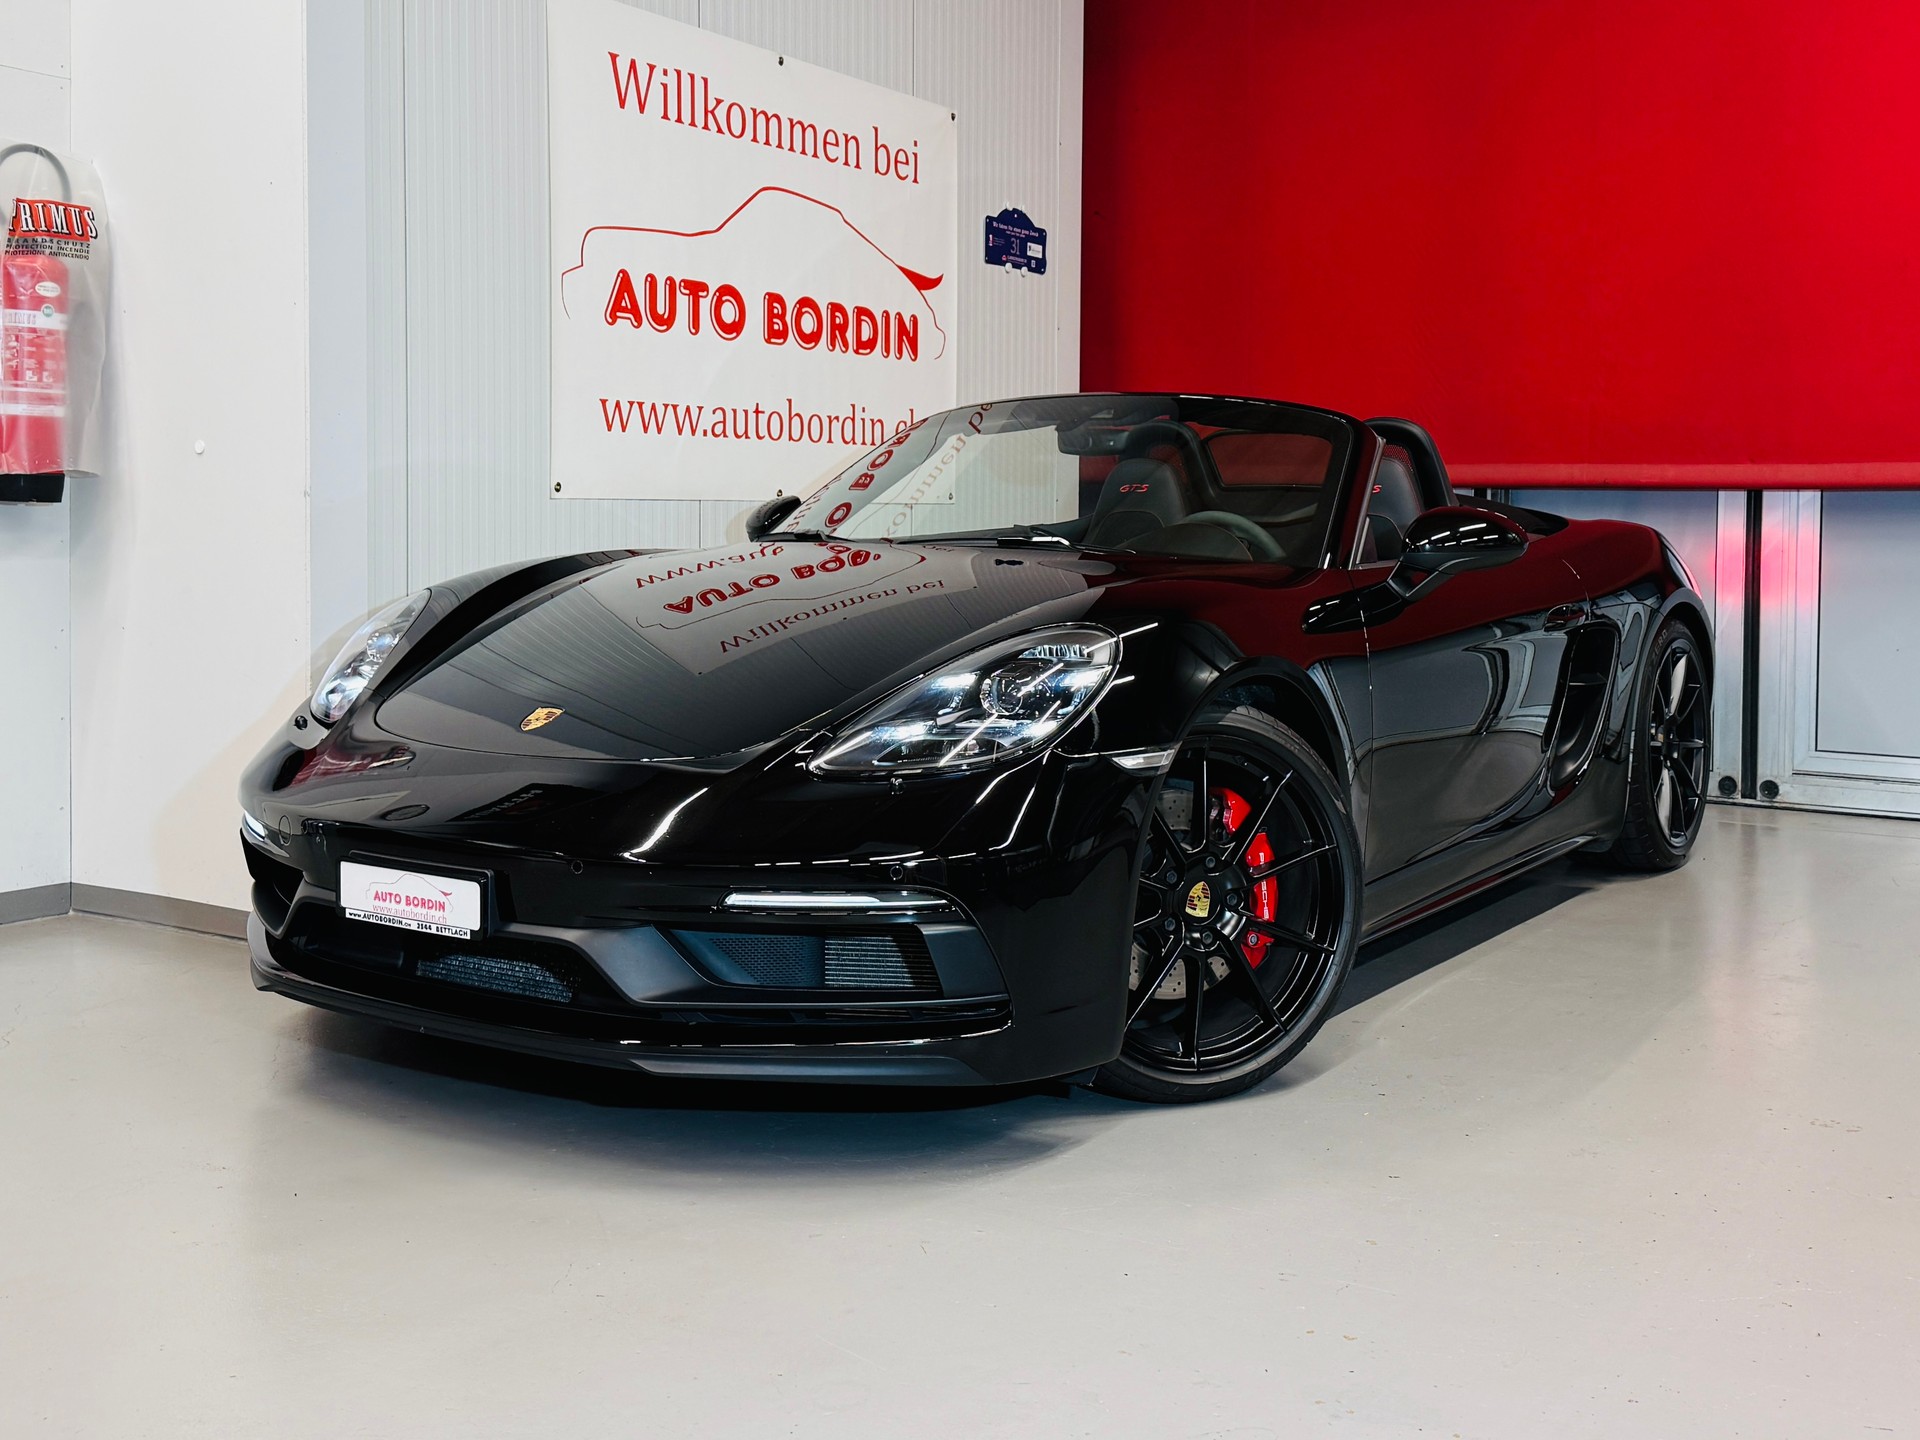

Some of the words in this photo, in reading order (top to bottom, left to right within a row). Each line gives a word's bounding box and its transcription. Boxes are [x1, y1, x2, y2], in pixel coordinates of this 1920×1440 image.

[608, 51, 862, 170] Willkommen
[872, 125, 919, 184] bei
[57, 246, 90, 255] INCENDIE
[604, 268, 746, 341] AUTO
[763, 291, 918, 362] BORDIN
[599, 398, 914, 447] www.autobordinc
[1120, 484, 1149, 492] GTS
[374, 890, 402, 905] AUTO
[405, 895, 446, 913] BORDIN
[372, 904, 447, 924] www.autobordin.ch
[436, 926, 468, 937] BETTLACH
